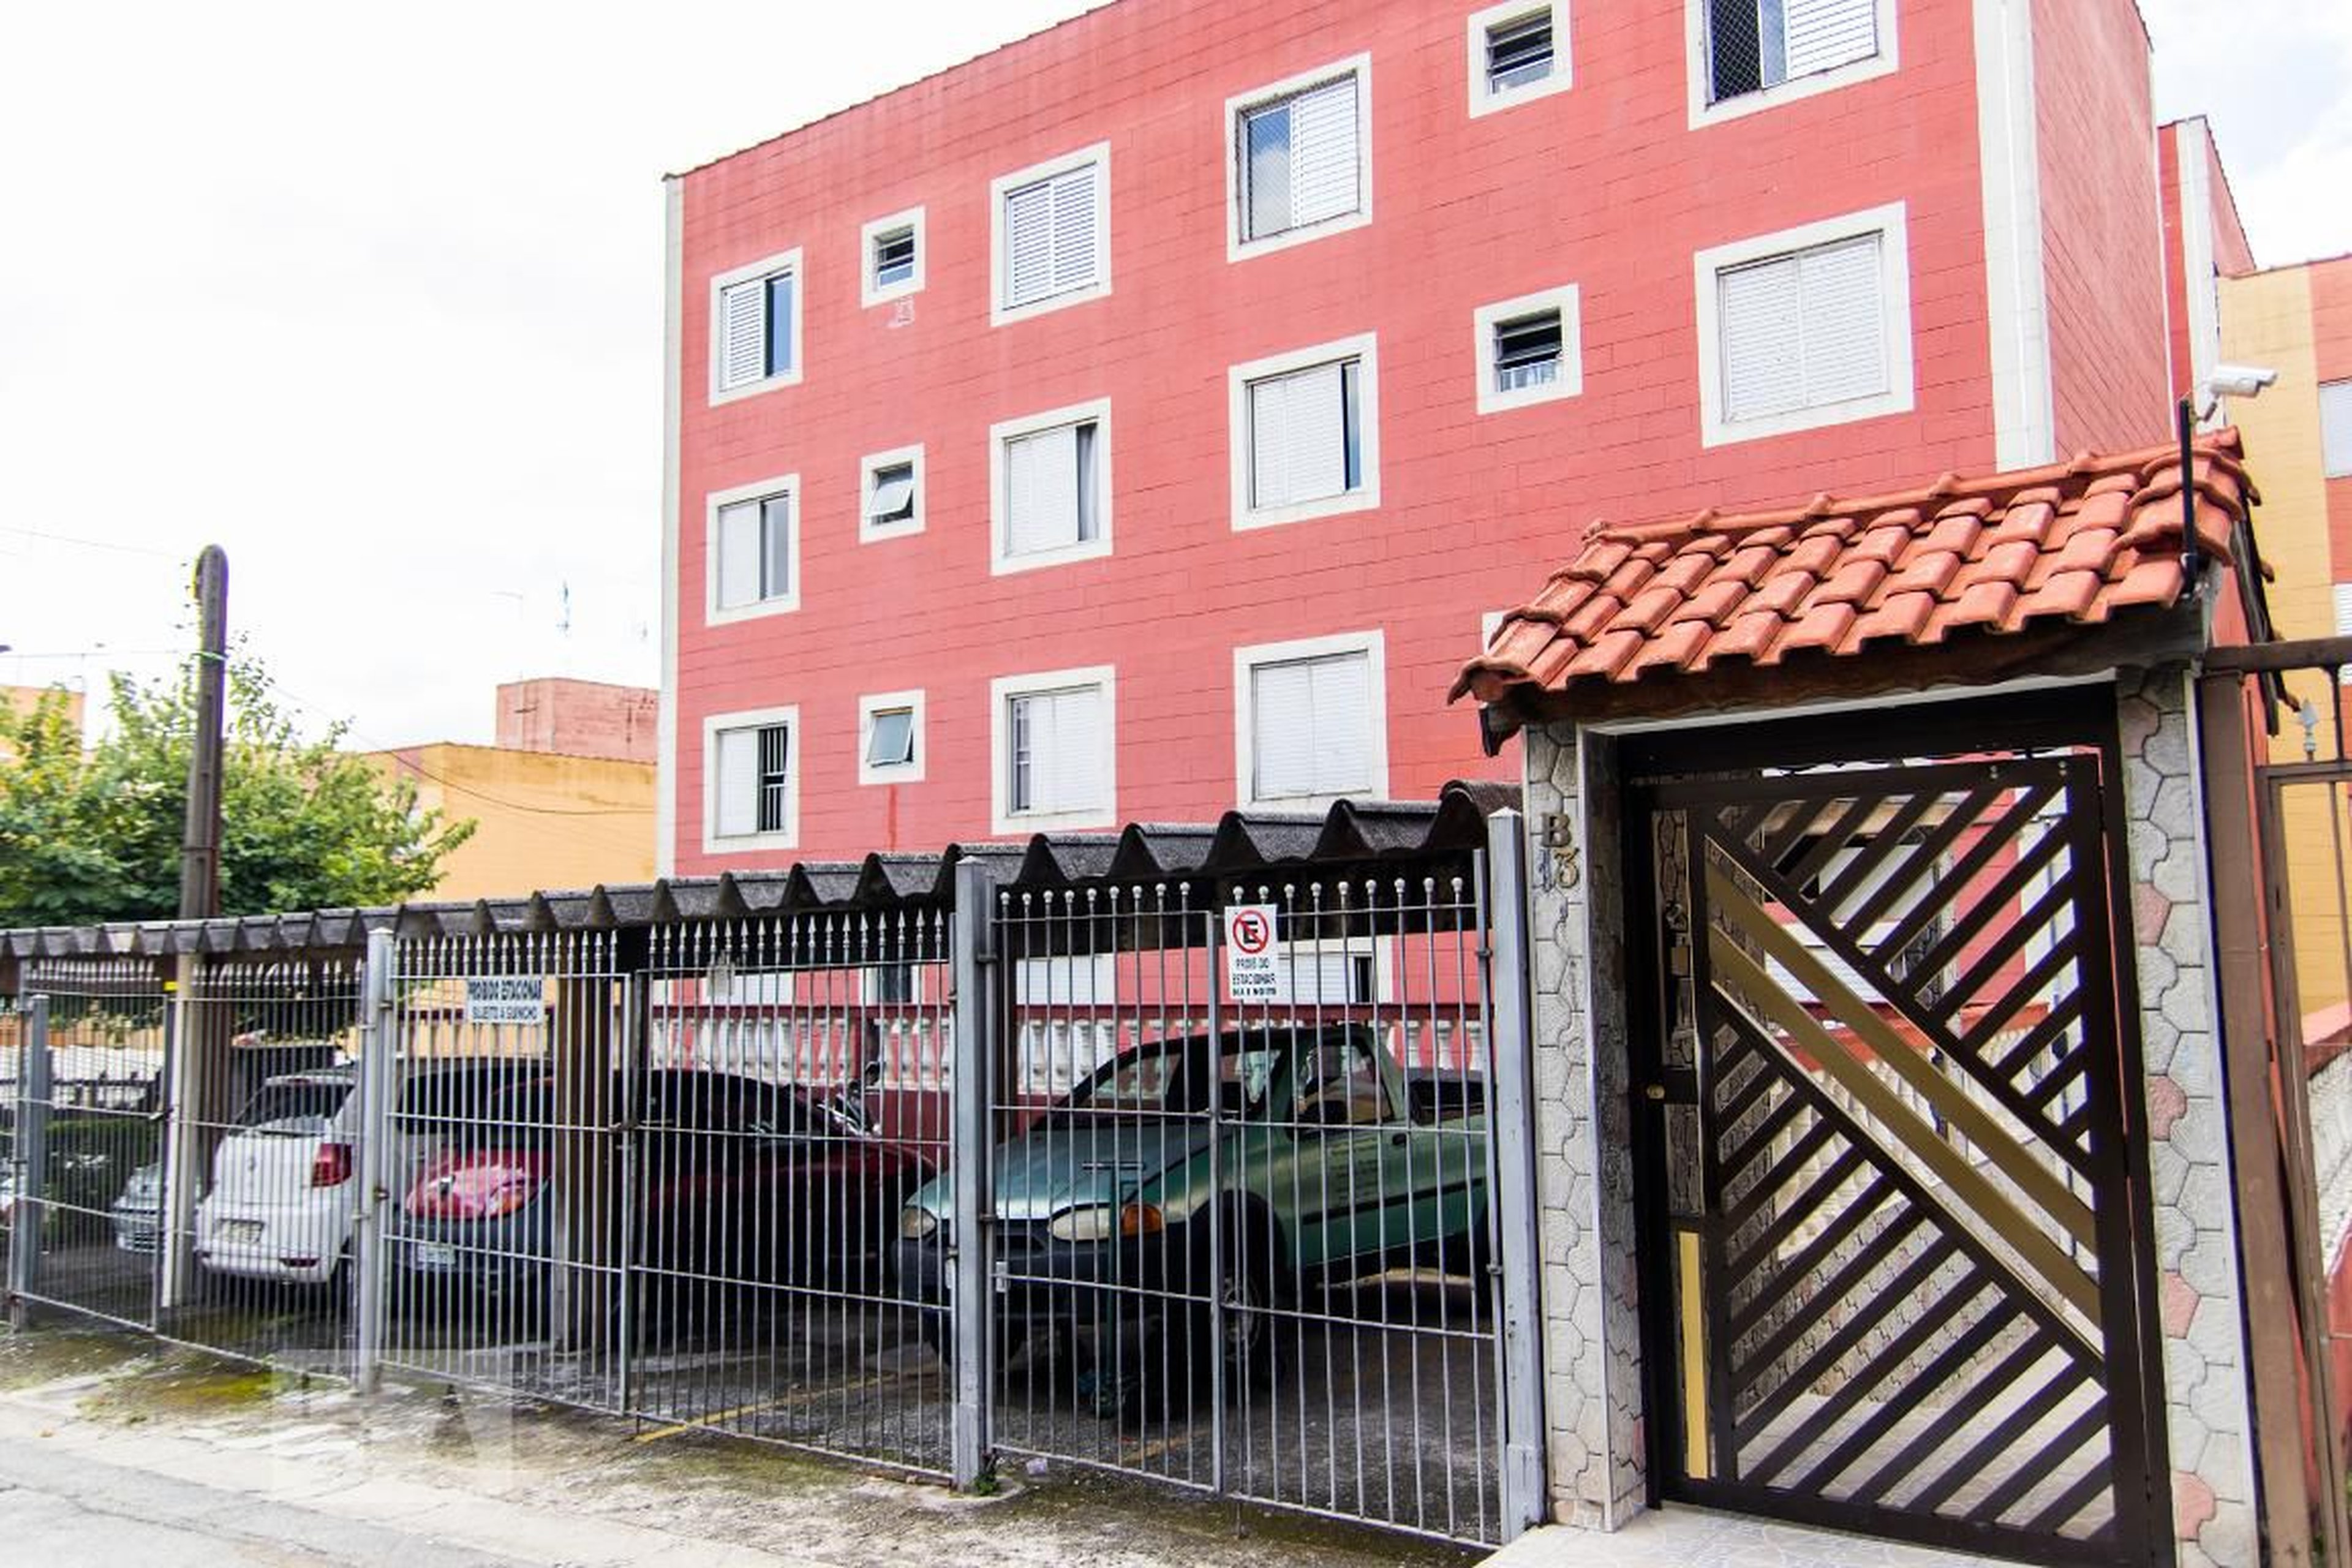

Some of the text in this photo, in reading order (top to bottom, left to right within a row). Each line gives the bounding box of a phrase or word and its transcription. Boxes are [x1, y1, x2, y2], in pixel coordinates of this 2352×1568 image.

[1542, 813, 1572, 848] B
[1243, 920, 1258, 944] E
[1232, 973, 1276, 986] ESTACIONAR
